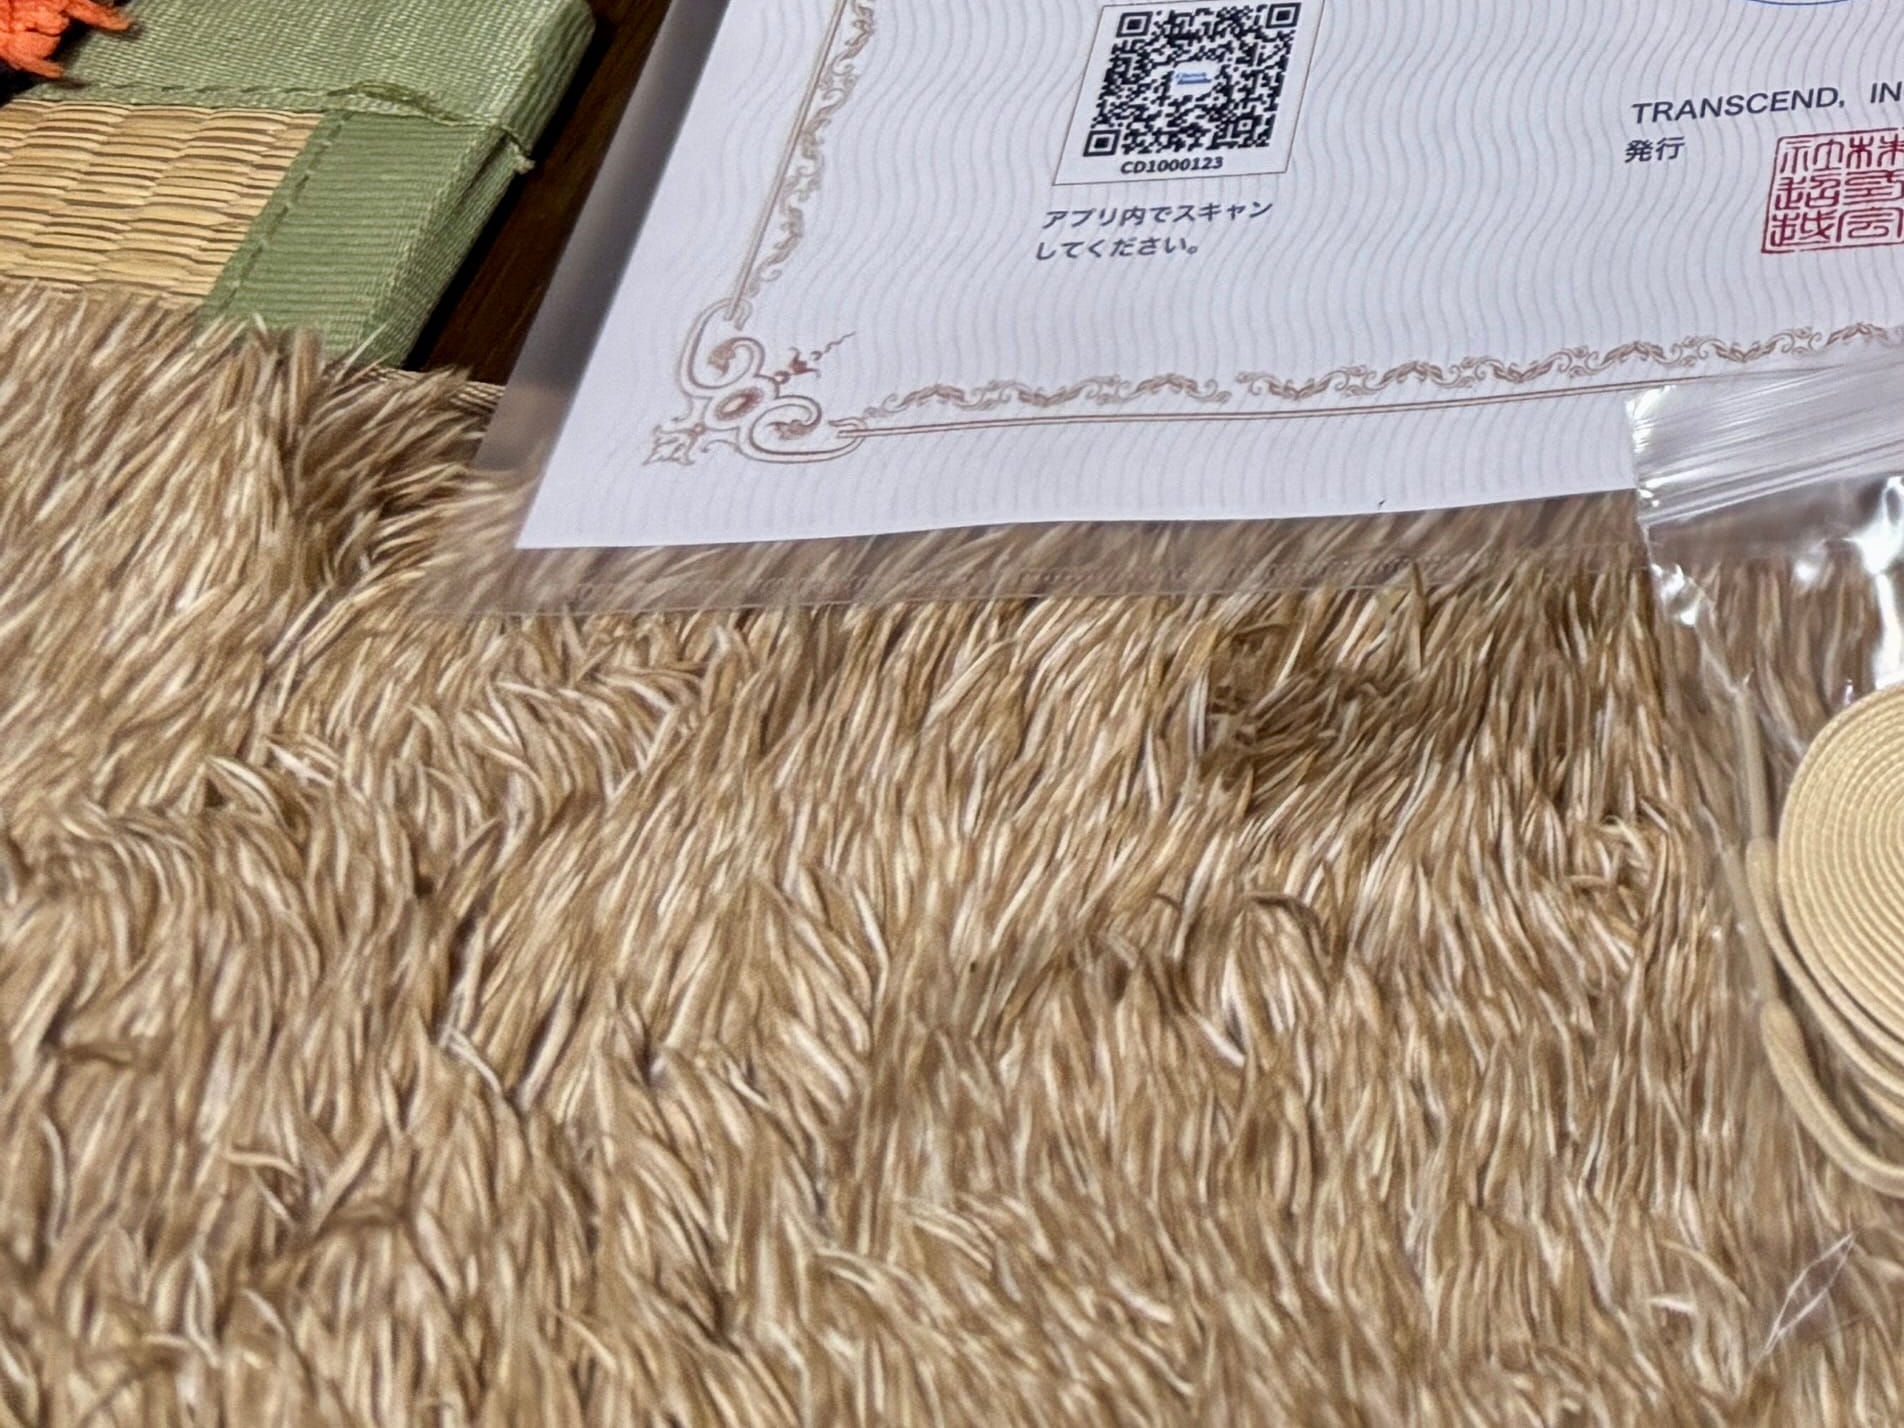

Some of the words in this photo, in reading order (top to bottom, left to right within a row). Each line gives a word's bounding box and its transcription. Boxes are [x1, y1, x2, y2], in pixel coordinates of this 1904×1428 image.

[1630, 86, 1846, 125] TRANSCEND,
[1624, 135, 1686, 164] 発行
[1120, 156, 1224, 175] CD1000123
[1041, 200, 1273, 230] アプリ内でスキャン
[1035, 236, 1200, 261] してください。
